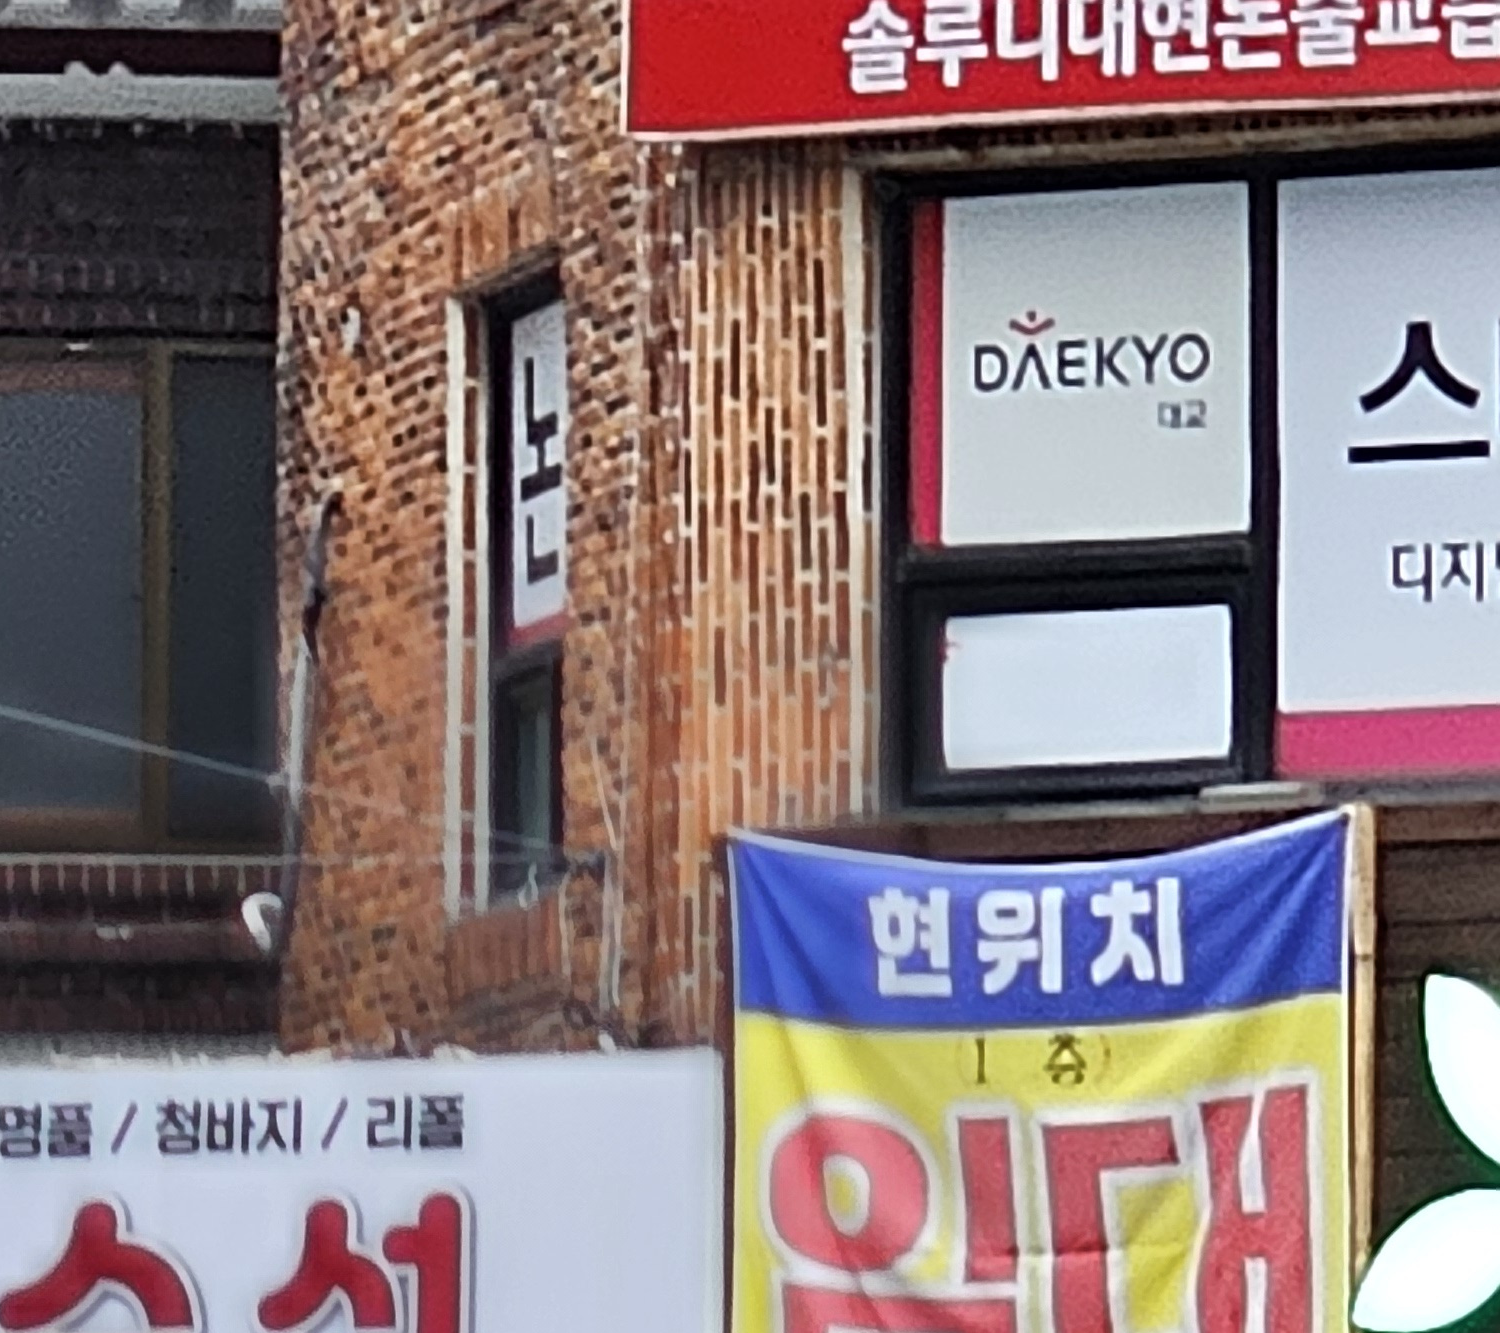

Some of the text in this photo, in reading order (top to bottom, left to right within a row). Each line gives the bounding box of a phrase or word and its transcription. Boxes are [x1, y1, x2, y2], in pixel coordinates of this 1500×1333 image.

[973, 333, 1211, 392] DAEKYO
[1347, 320, 1500, 465] 스
[1391, 540, 1500, 603] 디지
[866, 877, 1184, 997] 현위치
[154, 1096, 303, 1157] 청바지
